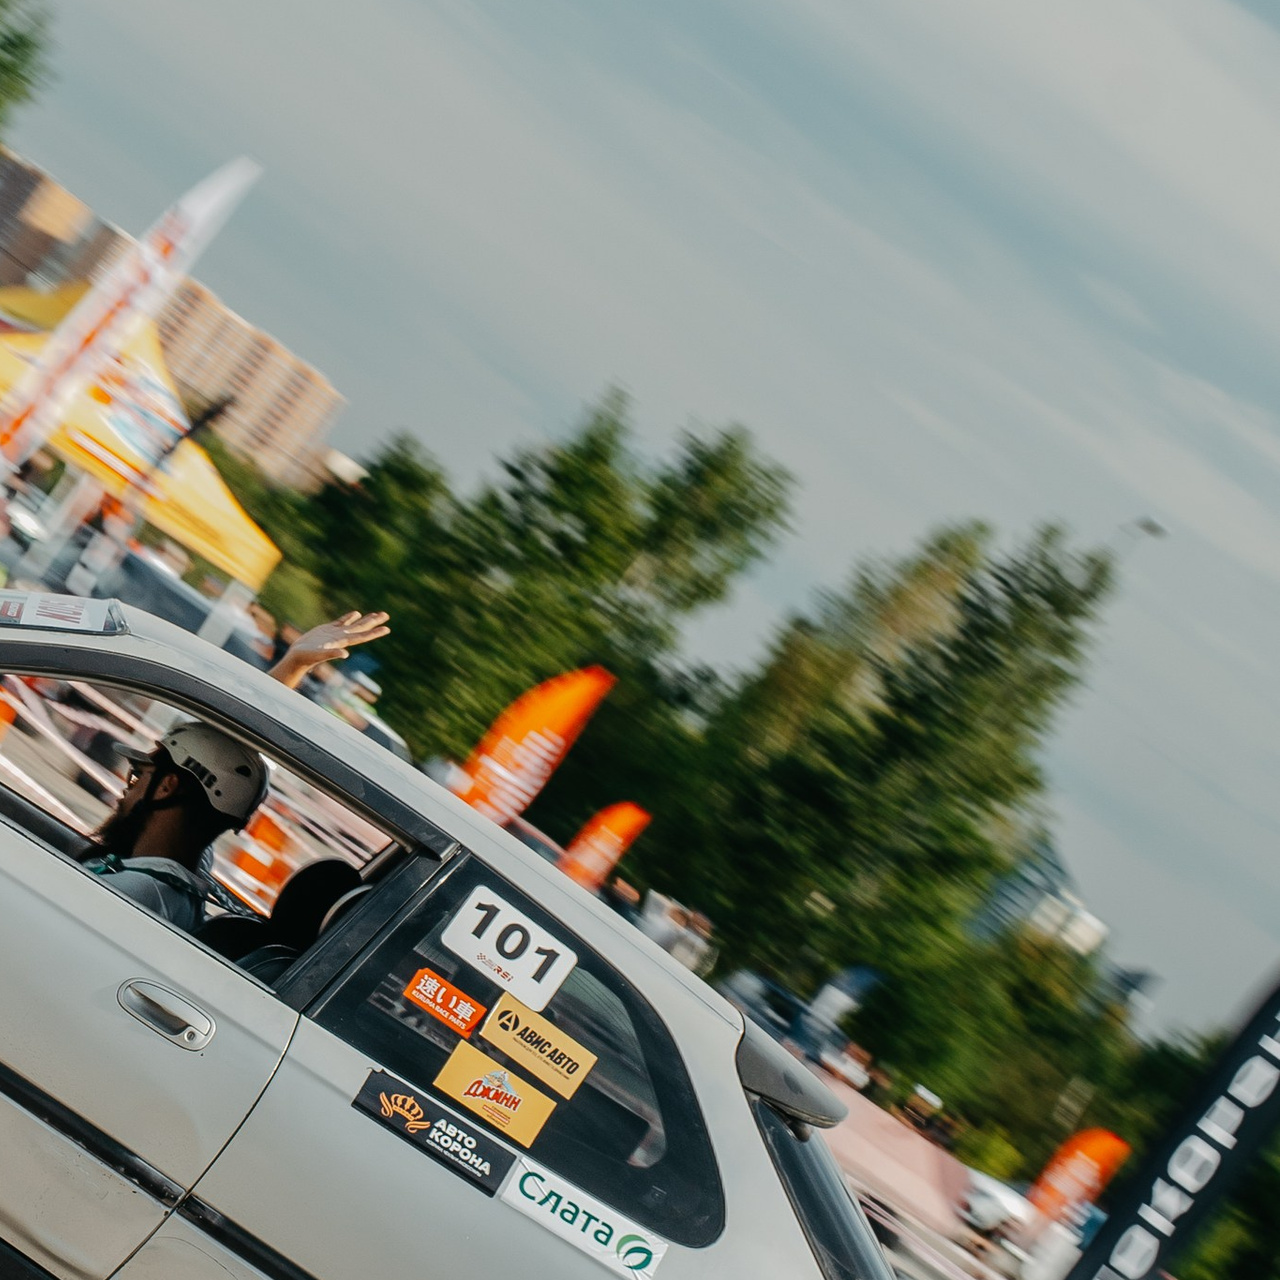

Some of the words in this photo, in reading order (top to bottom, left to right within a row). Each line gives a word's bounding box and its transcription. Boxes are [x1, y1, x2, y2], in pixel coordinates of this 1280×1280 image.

[471, 902, 560, 984] 101
[411, 989, 436, 1010] KURUMA
[434, 1004, 450, 1019] RACE
[448, 1014, 467, 1030] PARTS
[415, 974, 477, 1022] 速い車
[516, 1026, 552, 1054] АВИС
[546, 1048, 580, 1075] АВТО
[428, 1129, 491, 1176] КОРОНА
[434, 1119, 477, 1149] АВТО
[519, 1171, 614, 1246] Слата
